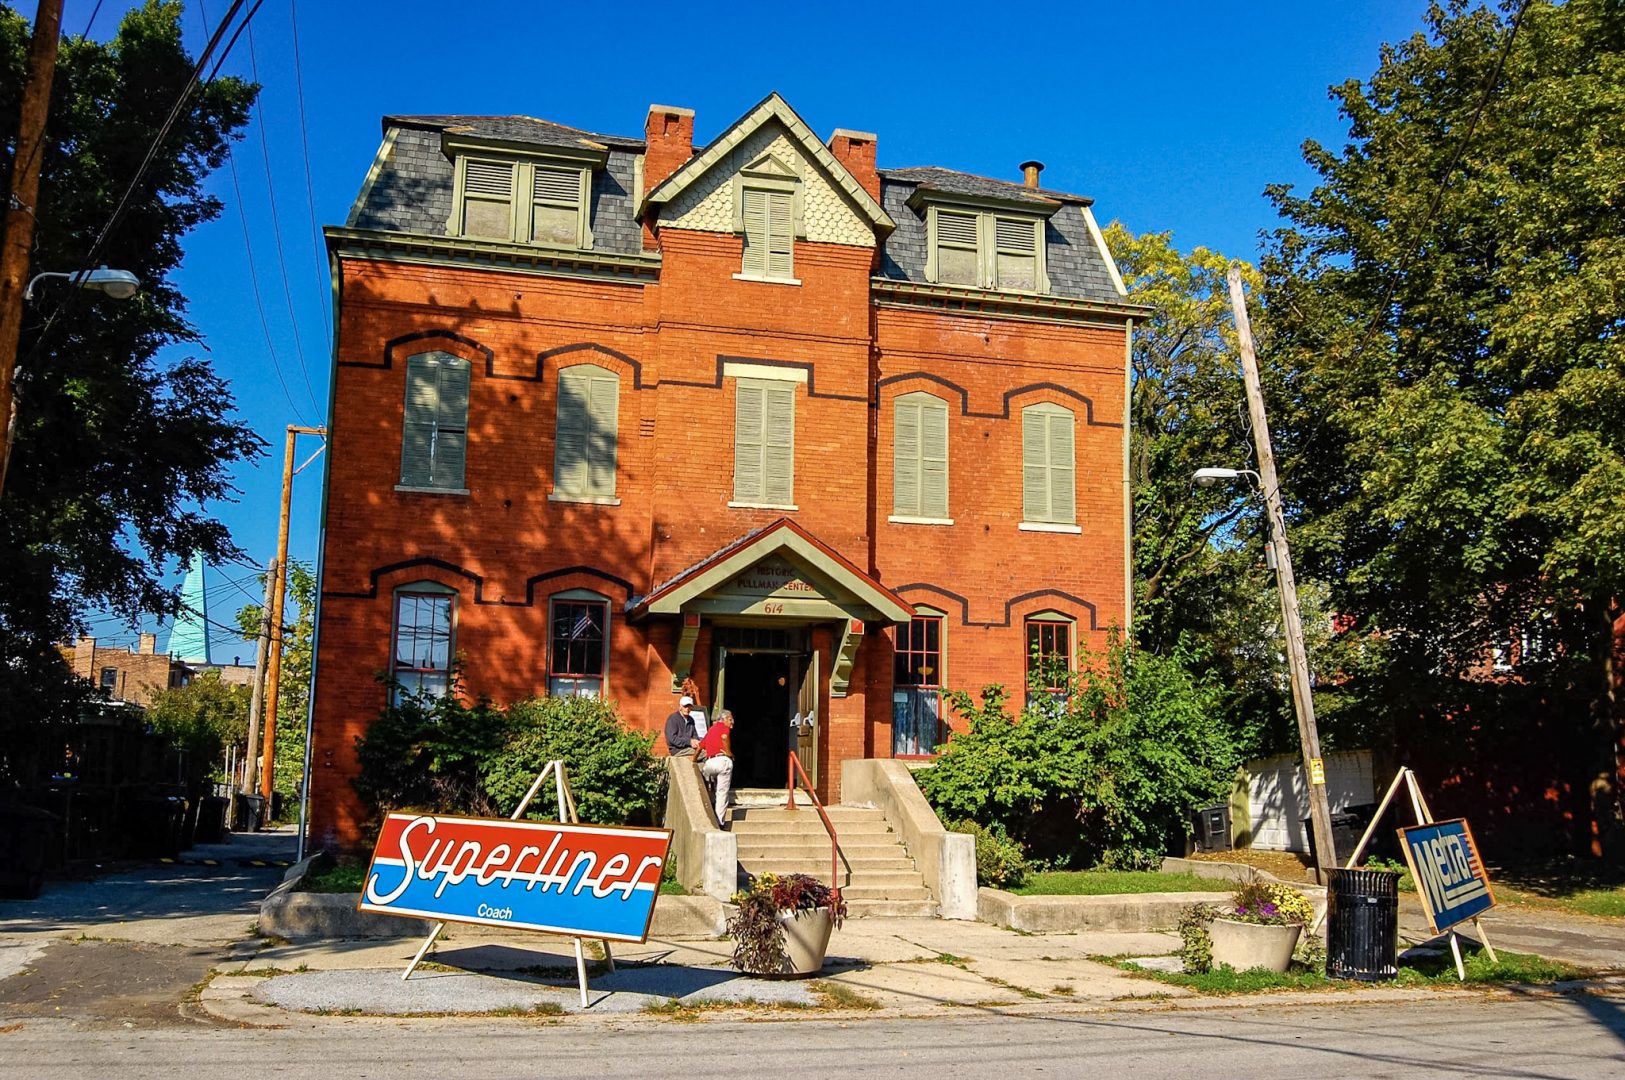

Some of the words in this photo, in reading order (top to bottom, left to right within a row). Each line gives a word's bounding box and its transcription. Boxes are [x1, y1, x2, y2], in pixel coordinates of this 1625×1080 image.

[757, 567, 795, 577] HISTORIC
[737, 579, 779, 590] PULLMAN
[783, 581, 815, 592] CENTER
[764, 603, 784, 614] 614
[366, 815, 662, 905] Superliner
[1412, 829, 1474, 916] Metra
[477, 903, 513, 920] Coach
